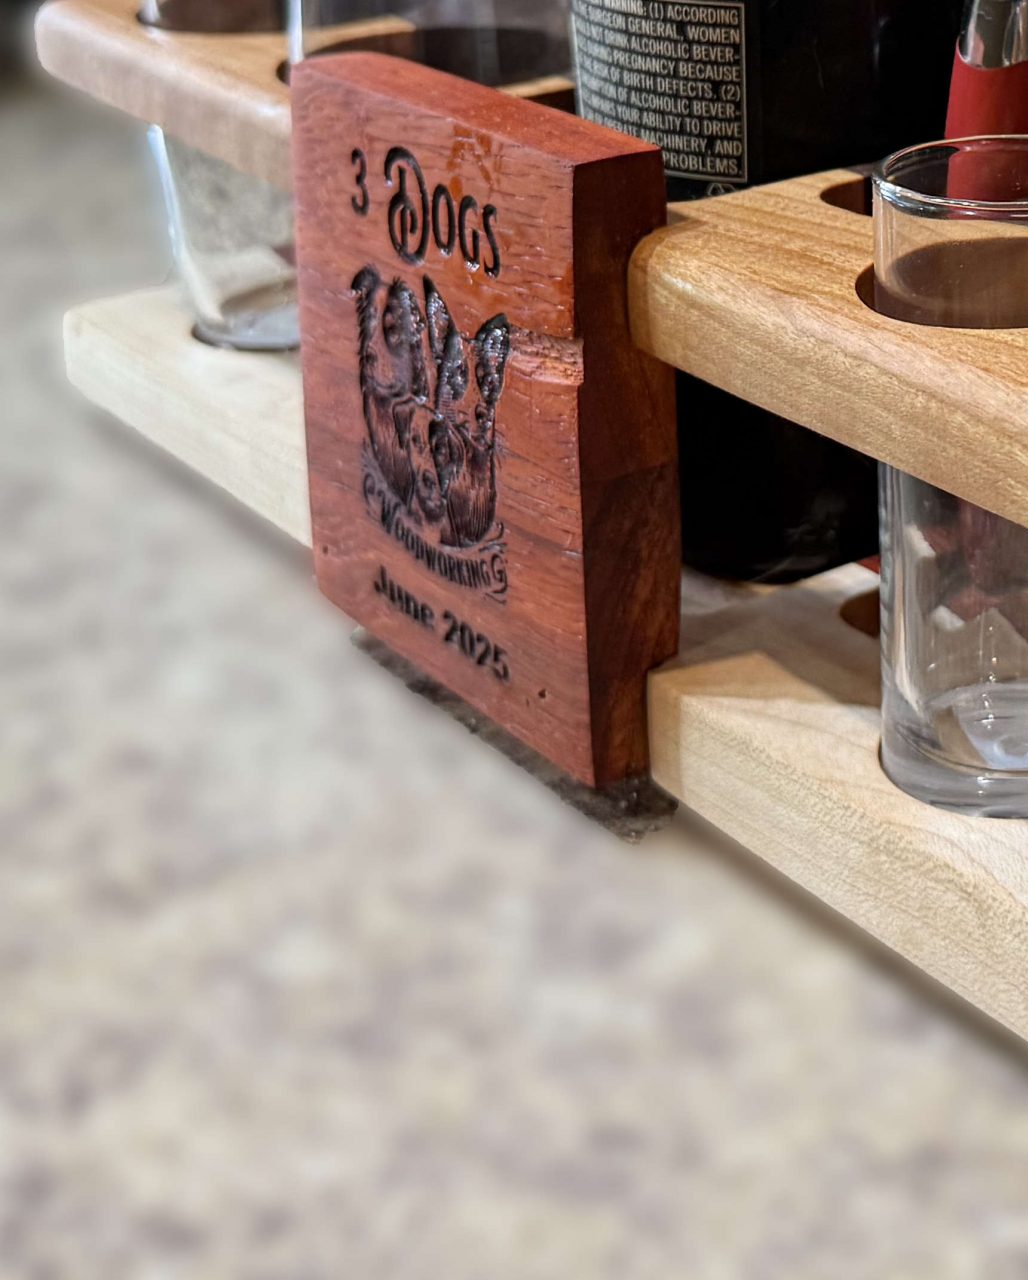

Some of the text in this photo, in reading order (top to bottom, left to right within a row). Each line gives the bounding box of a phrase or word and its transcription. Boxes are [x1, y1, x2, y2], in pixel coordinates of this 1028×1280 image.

[649, 2, 664, 20] (1)
[667, 4, 739, 26] ACCORDING
[628, 16, 684, 41] GENERAL,
[687, 24, 741, 45] WOMEN
[631, 35, 690, 60] ALCOHOLIC
[692, 44, 741, 63] BEVER-
[613, 49, 675, 76] PREGNANCY
[680, 60, 741, 83] BECAUSE
[623, 69, 654, 91] BIRTH
[721, 84, 741, 102] (2)
[631, 89, 690, 116] ALCOHOLIC
[693, 100, 742, 119] BEVER-
[617, 104, 641, 124] YOUR
[642, 110, 681, 133] ABILITY
[686, 118, 700, 134] TO
[703, 121, 743, 139] DRIVE
[641, 128, 711, 154] MACHINERY,
[715, 139, 743, 158] AND
[662, 150, 743, 176] PROBLEMS.
[351, 147, 369, 217] 3
[373, 564, 511, 682] June 2025
